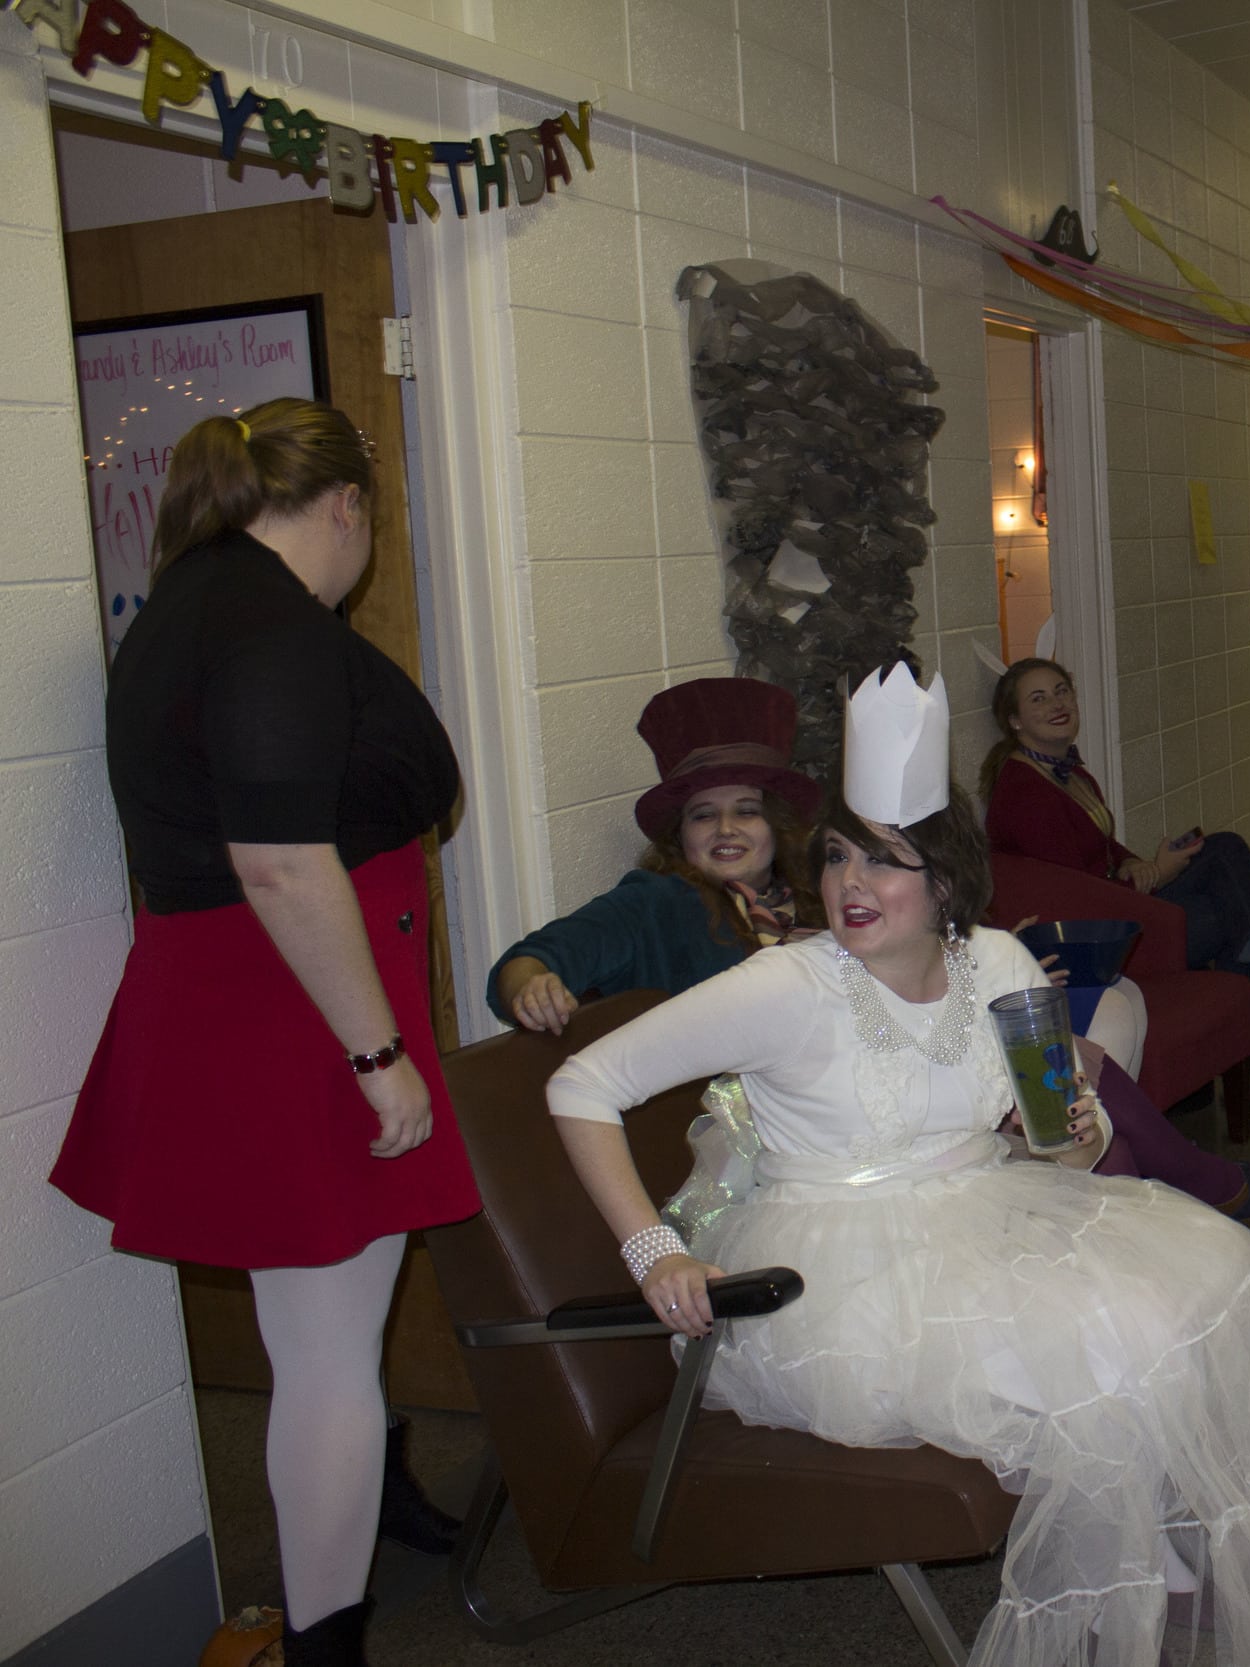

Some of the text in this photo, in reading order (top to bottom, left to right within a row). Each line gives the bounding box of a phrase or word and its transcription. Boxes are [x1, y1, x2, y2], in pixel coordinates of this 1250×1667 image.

[0, 0, 595, 224] APPY BIRTHDAY
[80, 345, 127, 397] andy
[152, 330, 233, 388] Ashley's
[242, 323, 296, 368] Room
